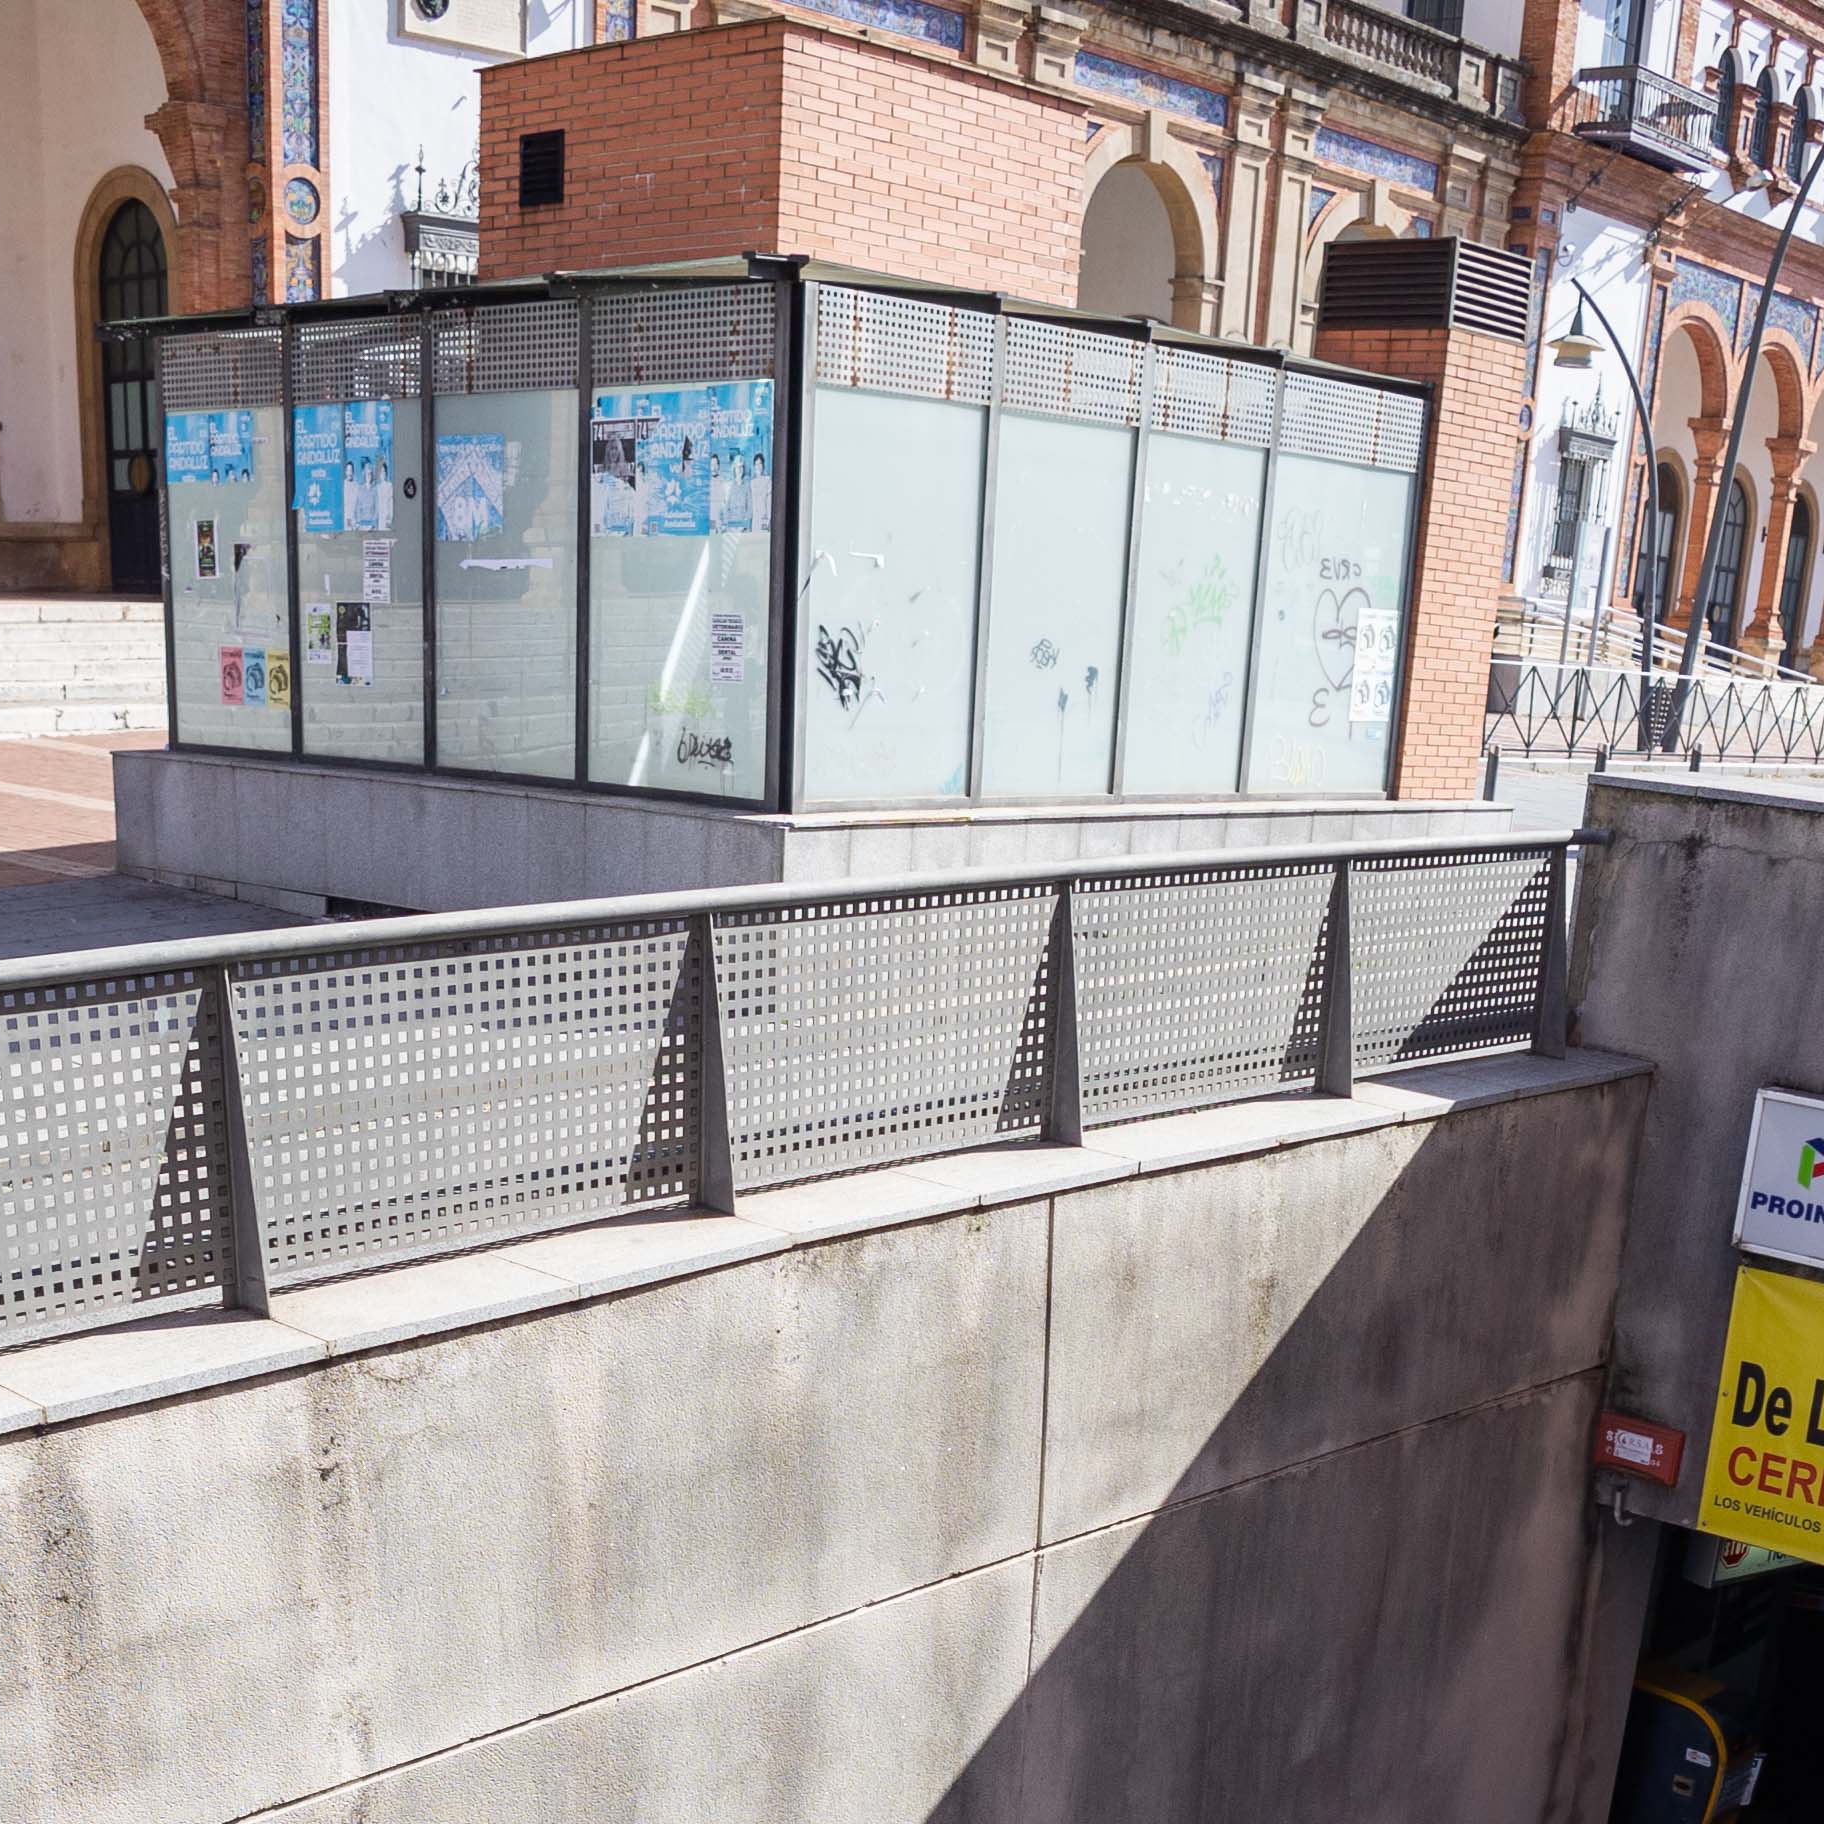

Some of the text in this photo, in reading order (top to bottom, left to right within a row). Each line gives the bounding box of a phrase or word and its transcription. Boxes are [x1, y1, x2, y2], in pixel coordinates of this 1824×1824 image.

[296, 433, 337, 449] PARTIDO
[297, 449, 341, 465] ANDALUZ
[1731, 1360, 1793, 1436] De
[1713, 1494, 1741, 1513] LOS
